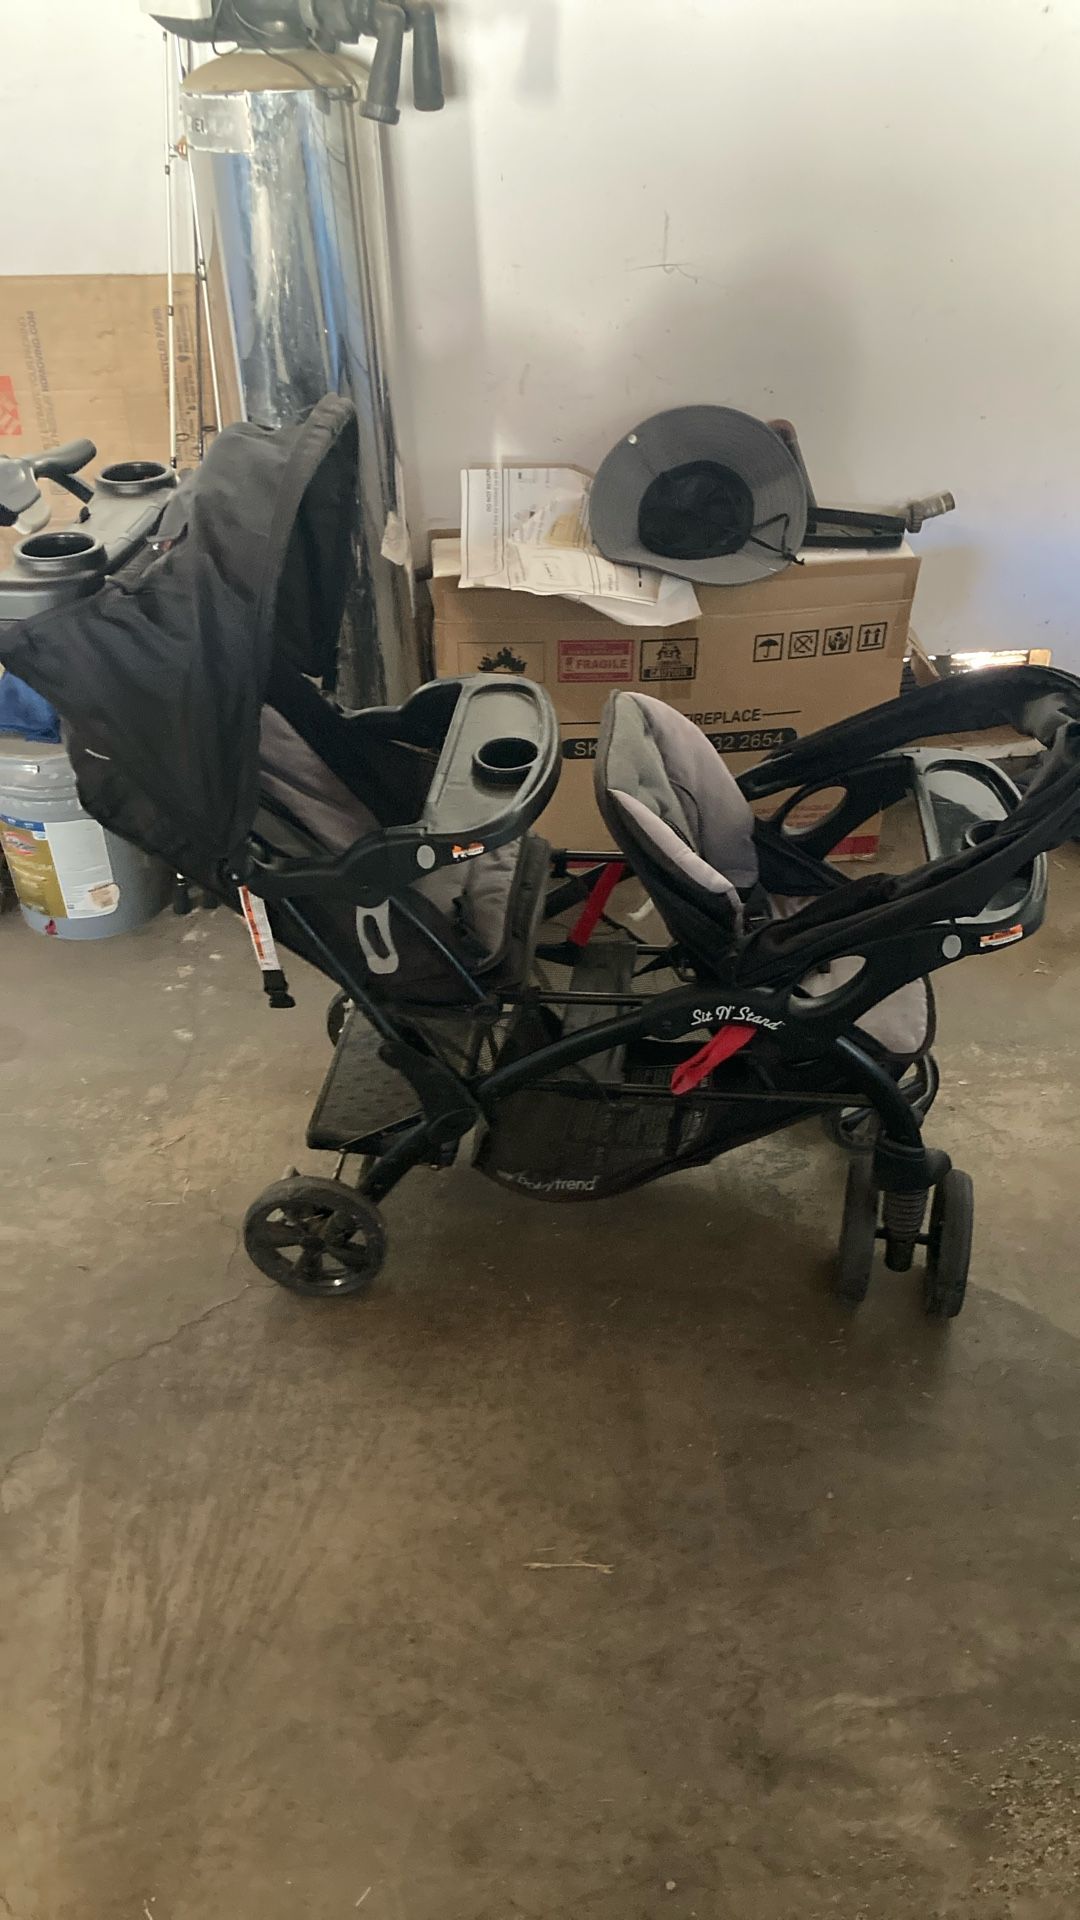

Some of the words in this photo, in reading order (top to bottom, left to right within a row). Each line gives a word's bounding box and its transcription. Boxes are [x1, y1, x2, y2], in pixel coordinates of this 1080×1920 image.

[576, 658, 628, 669] FRAGILE
[739, 732, 784, 749] 2654
[691, 1009, 713, 1025] Sit
[733, 1006, 782, 1030] Stand
